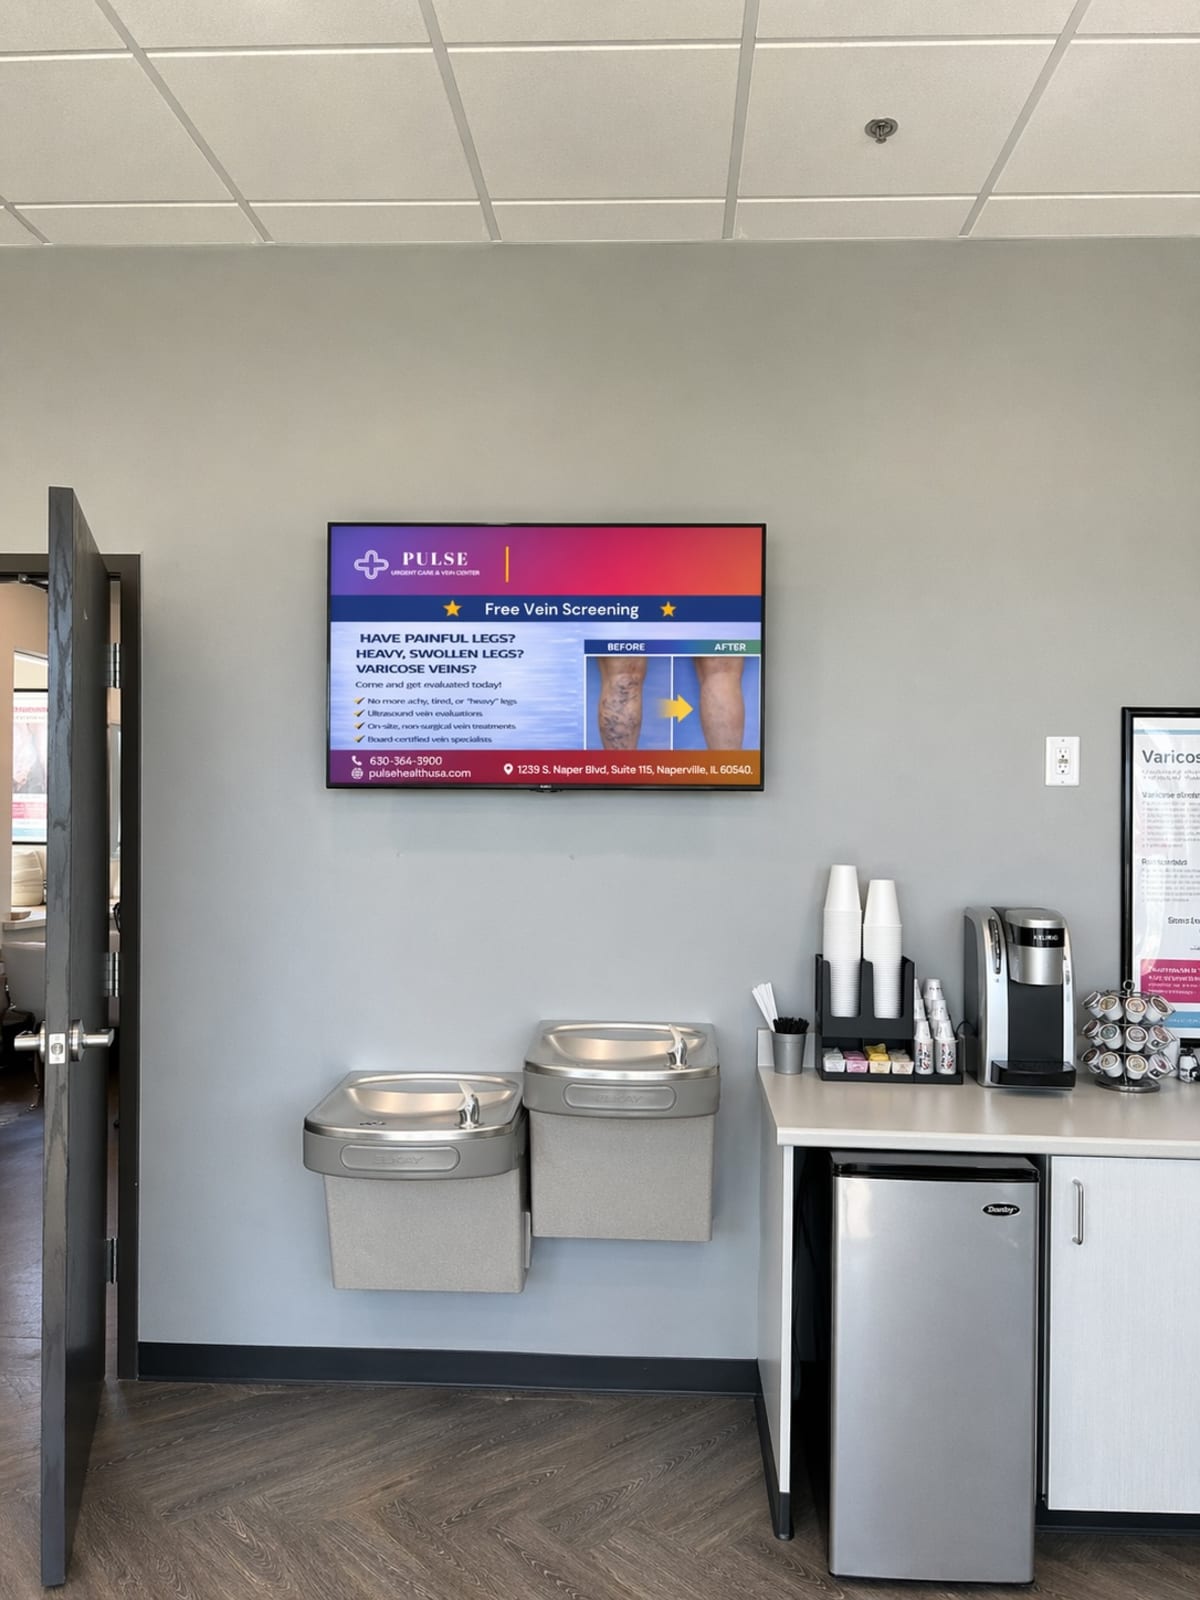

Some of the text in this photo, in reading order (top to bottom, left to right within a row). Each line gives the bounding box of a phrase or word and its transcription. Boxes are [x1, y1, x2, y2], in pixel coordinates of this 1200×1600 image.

[402, 551, 468, 566] PULSE
[485, 602, 640, 620] Free Vein Screening
[360, 633, 516, 644] HAVE PAINFUL LEGS?
[607, 642, 646, 652] BEFORE
[714, 642, 747, 652] AFTER
[356, 648, 525, 660] HEAVY, SWOLLEN LEGS?
[356, 664, 477, 674] VARICOSE VEINS?
[355, 680, 502, 691] Come and get evaluated today!
[367, 697, 381, 705] No
[407, 697, 430, 707] achy,
[431, 697, 454, 706] tired,
[500, 697, 518, 707] legs
[367, 709, 414, 718] Ultrasound
[434, 709, 484, 718] evaluations
[367, 722, 517, 732] On-site, non-surgical vein treatments
[431, 735, 450, 744] vein
[450, 735, 493, 746] specialists
[369, 755, 443, 766] 630-364-3900
[368, 767, 472, 781] pulsehealthusa.com
[517, 764, 540, 775] 1239
[541, 764, 552, 775] S.
[552, 764, 583, 777] Naper
[584, 764, 609, 776] Blvd,
[610, 764, 637, 775] Suite
[638, 764, 655, 776] 115,
[656, 764, 709, 777] Naperville,
[709, 764, 719, 775] IL
